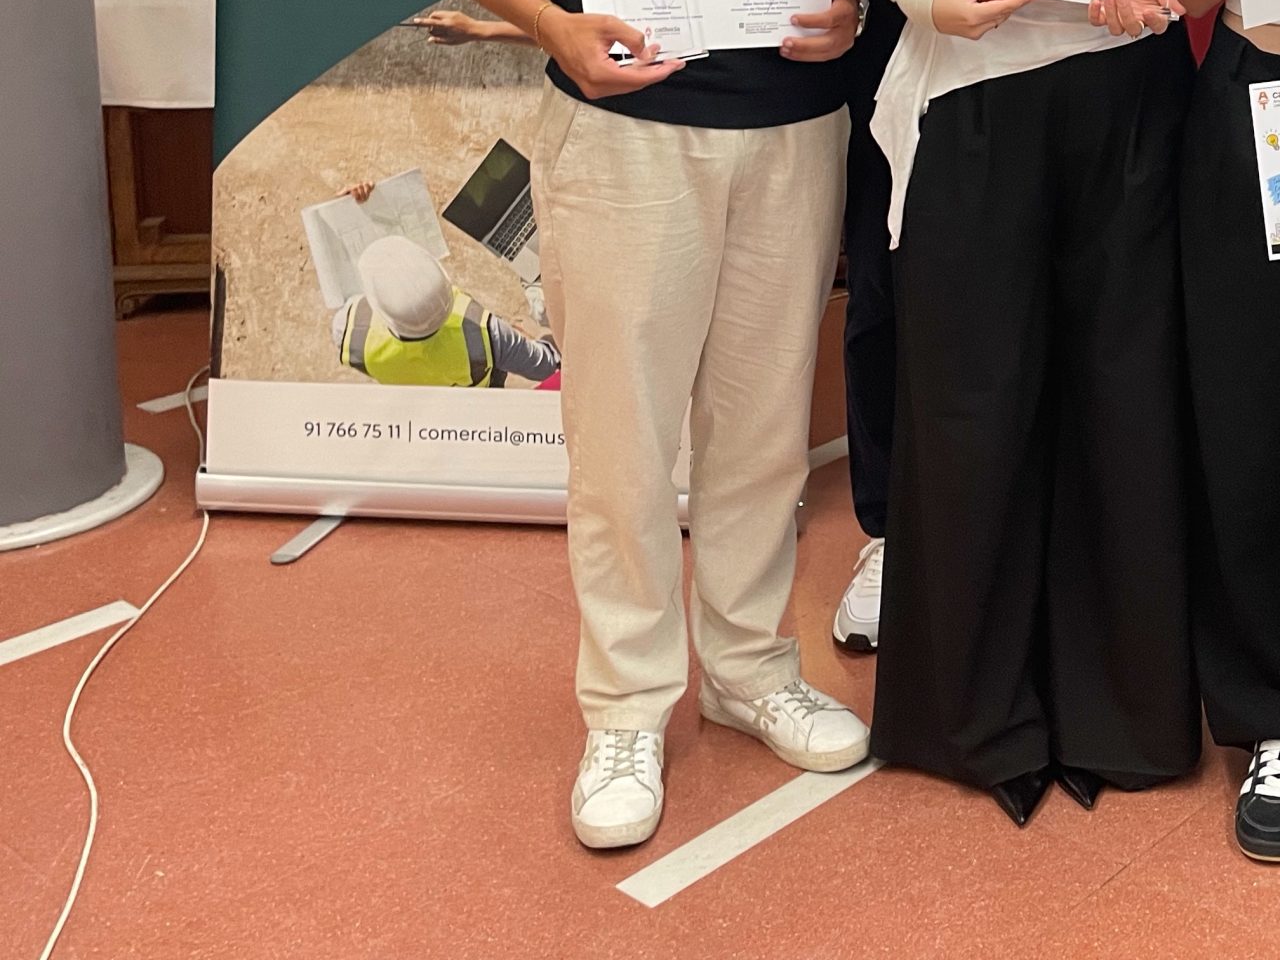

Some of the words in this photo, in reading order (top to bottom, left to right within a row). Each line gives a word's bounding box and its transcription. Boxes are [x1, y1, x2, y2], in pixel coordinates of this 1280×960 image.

[304, 422, 321, 437] 91
[327, 422, 358, 438] 766
[362, 424, 382, 439] 75
[388, 425, 401, 439] 11
[418, 426, 566, 446] comercial@mus
